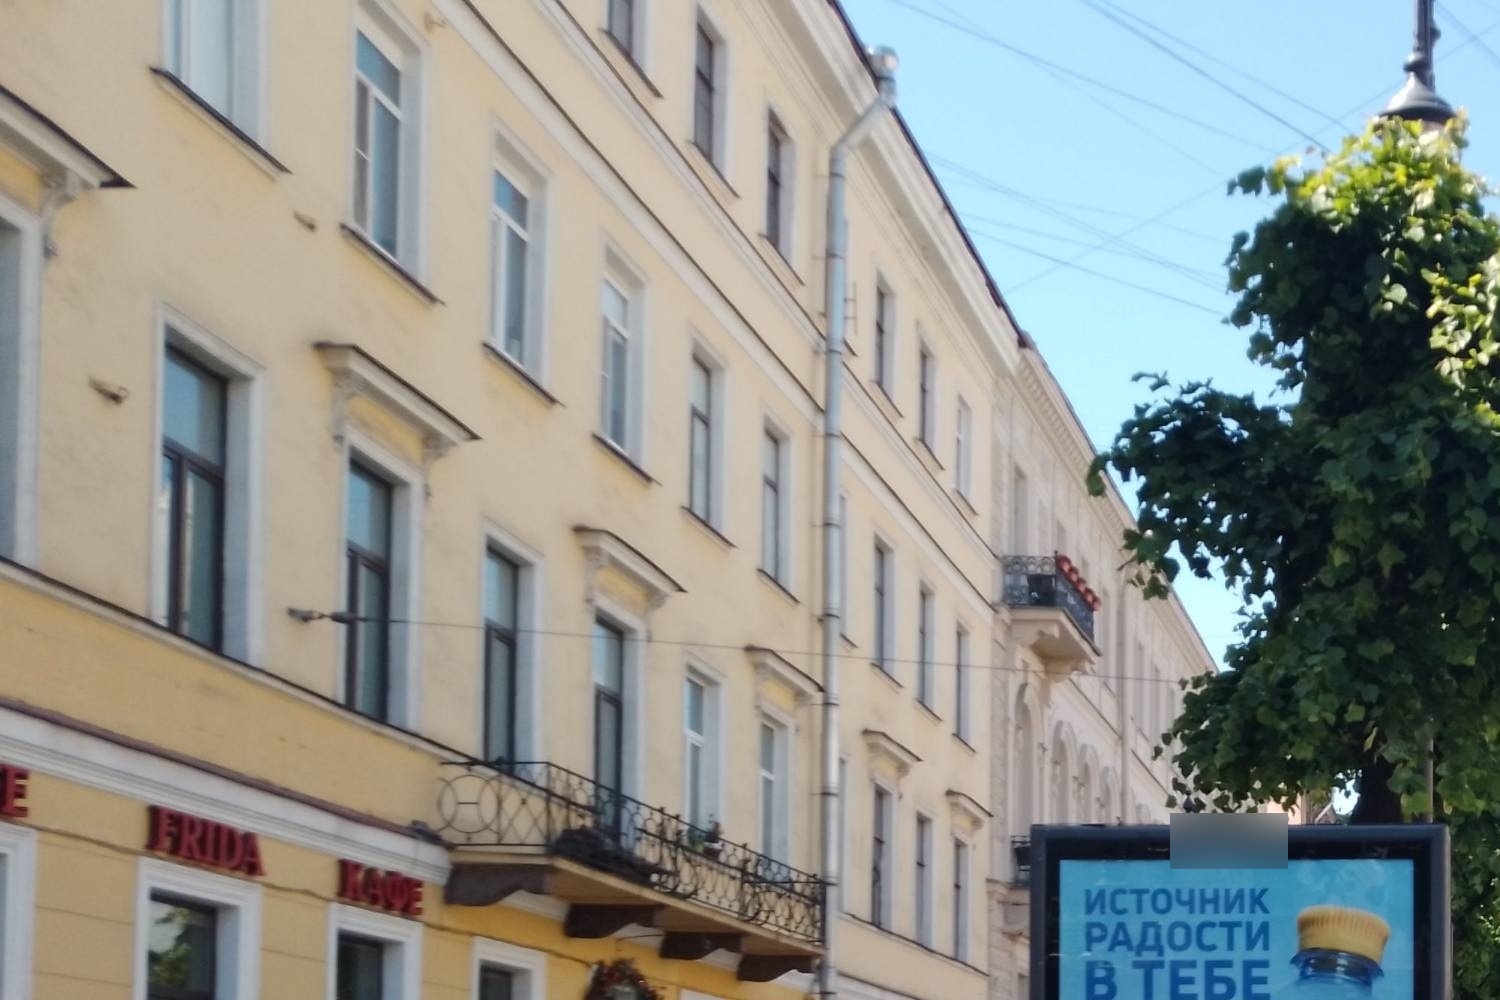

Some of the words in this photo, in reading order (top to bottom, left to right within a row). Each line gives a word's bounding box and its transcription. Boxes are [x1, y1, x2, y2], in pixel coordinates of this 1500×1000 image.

[146, 804, 266, 877] FRIDA
[337, 858, 424, 916] КАФЕ
[1085, 888, 1270, 915] ИСТОЧНИК
[1085, 921, 1270, 957] РАДОСТИ
